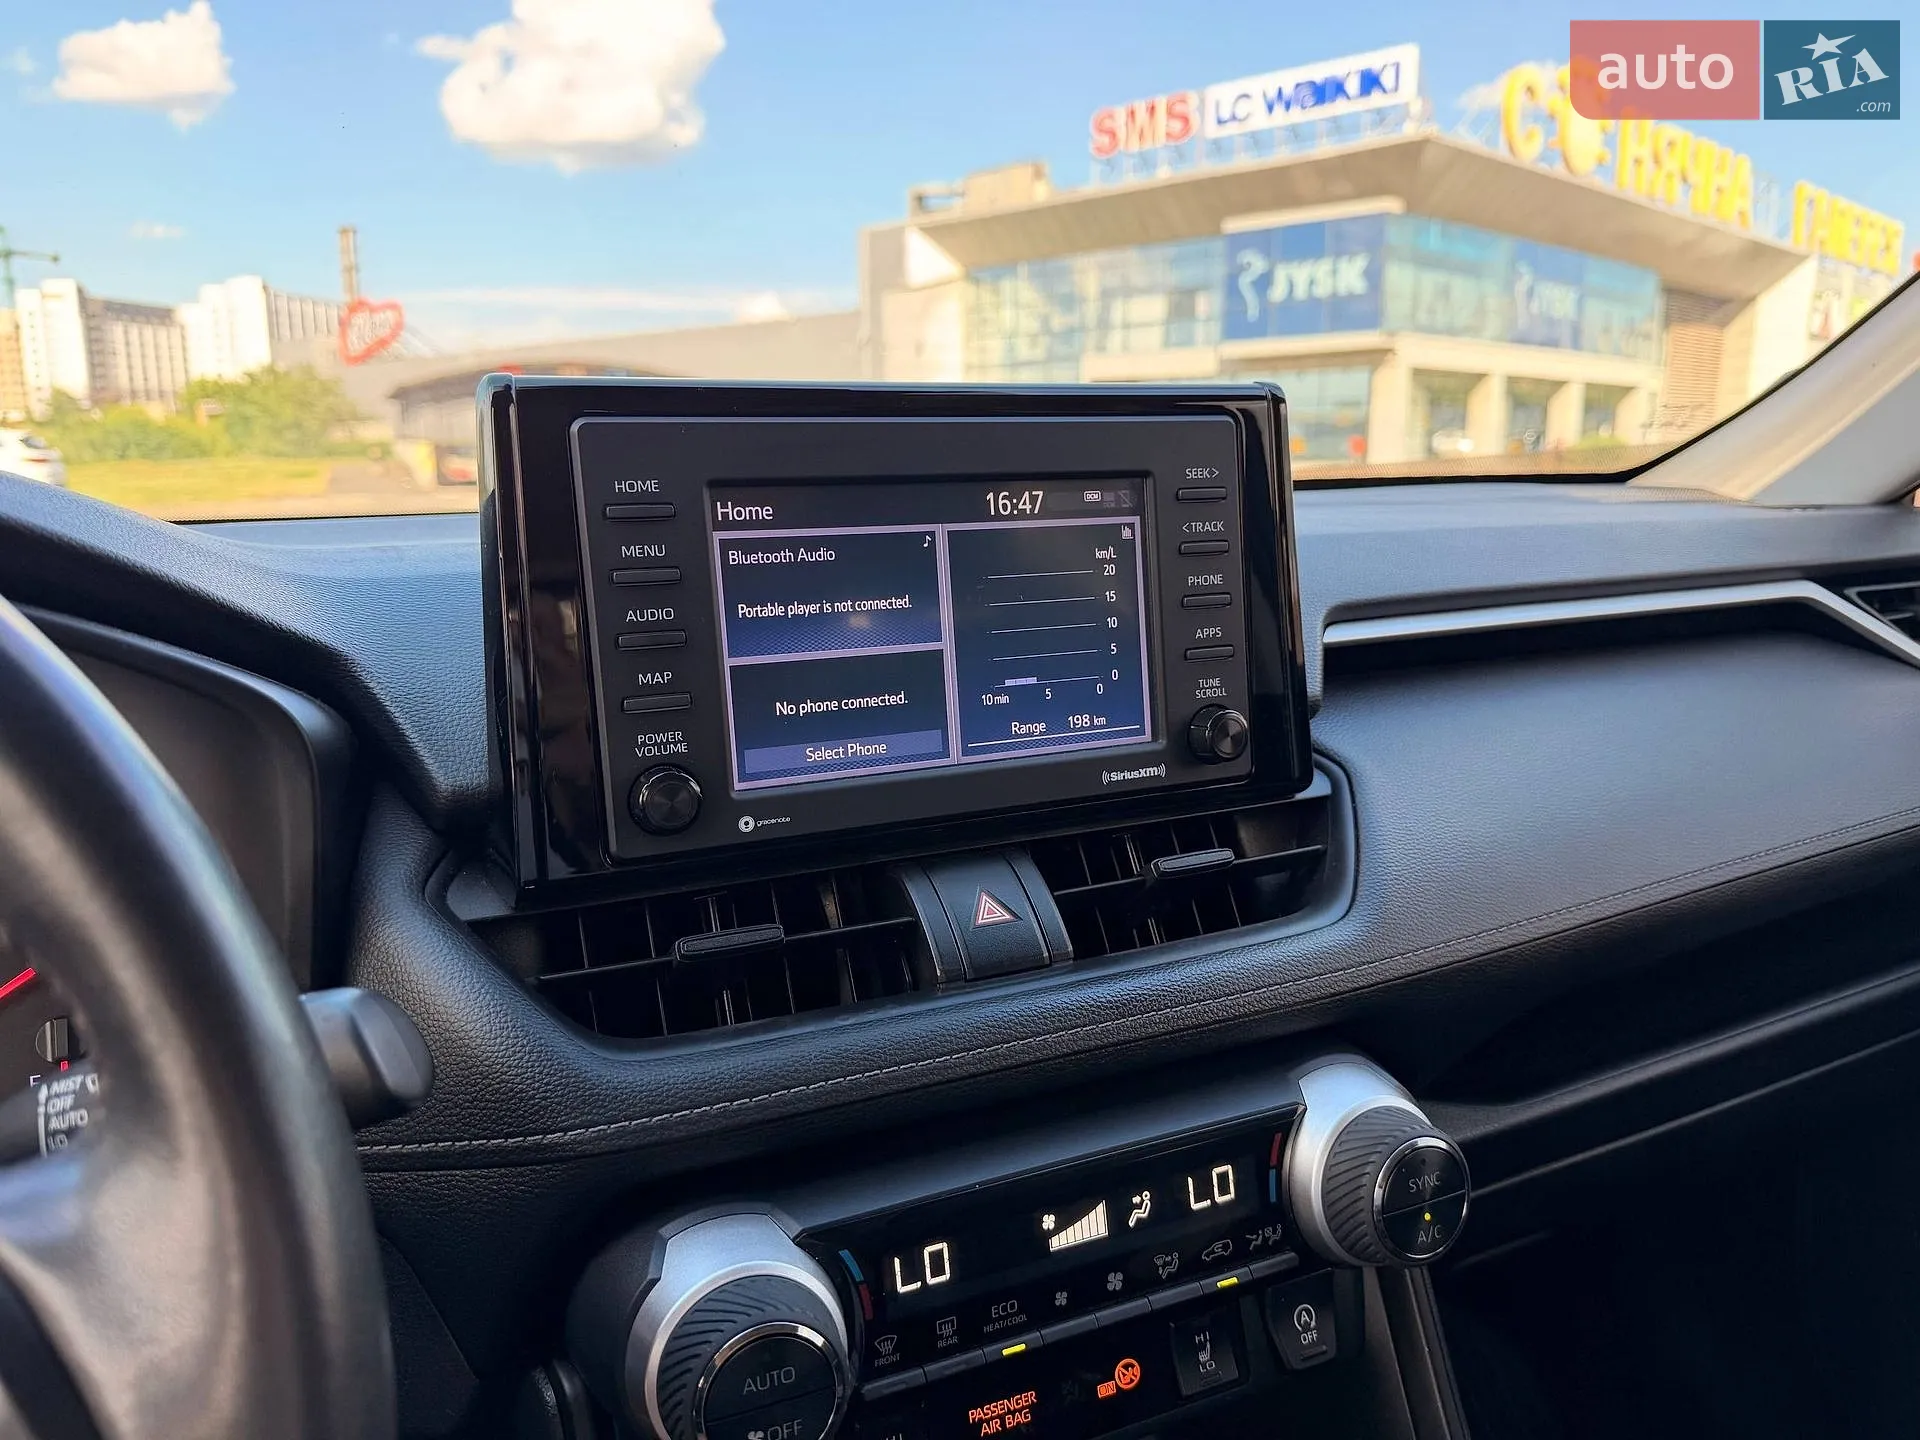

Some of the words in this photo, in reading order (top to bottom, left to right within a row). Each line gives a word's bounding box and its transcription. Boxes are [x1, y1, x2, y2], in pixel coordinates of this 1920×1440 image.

[1215, 93, 1252, 126] LC
[1267, 251, 1371, 304] JYSK
[614, 480, 660, 493] HOME
[716, 501, 774, 521] Home
[986, 490, 1044, 516] 16:47
[621, 544, 666, 558] MENU
[728, 548, 794, 565] Bluetooth
[797, 547, 836, 563] Audio
[1095, 545, 1117, 560] km/L
[1103, 564, 1116, 576] 20
[1188, 574, 1224, 586] PHONE
[1105, 590, 1116, 602] 15
[737, 601, 785, 618] Portable
[788, 599, 820, 618] player
[823, 600, 832, 613] is
[834, 600, 853, 613] not
[855, 594, 912, 611] connected.
[625, 607, 675, 623] AUDIO
[1106, 617, 1118, 629] 10
[1195, 627, 1222, 639] APPS
[1110, 643, 1117, 655] 5
[638, 671, 673, 686] MAP
[1111, 669, 1119, 681] 0
[1198, 678, 1221, 688] TUNE
[1045, 688, 1052, 700] 5
[1096, 683, 1103, 695] 0
[1195, 687, 1227, 699] SCROLL
[775, 700, 796, 716] No
[799, 698, 839, 717] phone
[841, 691, 909, 711] connected.
[981, 694, 993, 706] 10
[994, 693, 1010, 705] min
[1011, 721, 1047, 735] Range
[1067, 715, 1090, 729] 198
[1093, 715, 1106, 727] km
[637, 730, 684, 745] POWER
[635, 742, 689, 758] VOLUME
[805, 746, 845, 762] Select
[847, 741, 887, 758] Phone
[48, 1108, 89, 1132] AUTO
[1187, 1163, 1236, 1210] LO
[1408, 1171, 1442, 1193] SYNC
[1416, 1224, 1443, 1245] A/C
[893, 1240, 951, 1294] LO
[991, 1300, 1018, 1318] ECO
[983, 1313, 1028, 1333] HEAT/COOL
[937, 1335, 958, 1349] REAR
[1300, 1330, 1318, 1345] OFF
[874, 1352, 901, 1368] FRONT
[1200, 1360, 1216, 1373] LO
[743, 1366, 796, 1395] AUTO
[1098, 1381, 1116, 1397] ON
[968, 1391, 1038, 1425] PASSENGER
[766, 1419, 804, 1440] OFF
[981, 1417, 1002, 1438] AIR
[1005, 1409, 1032, 1430] BAG
